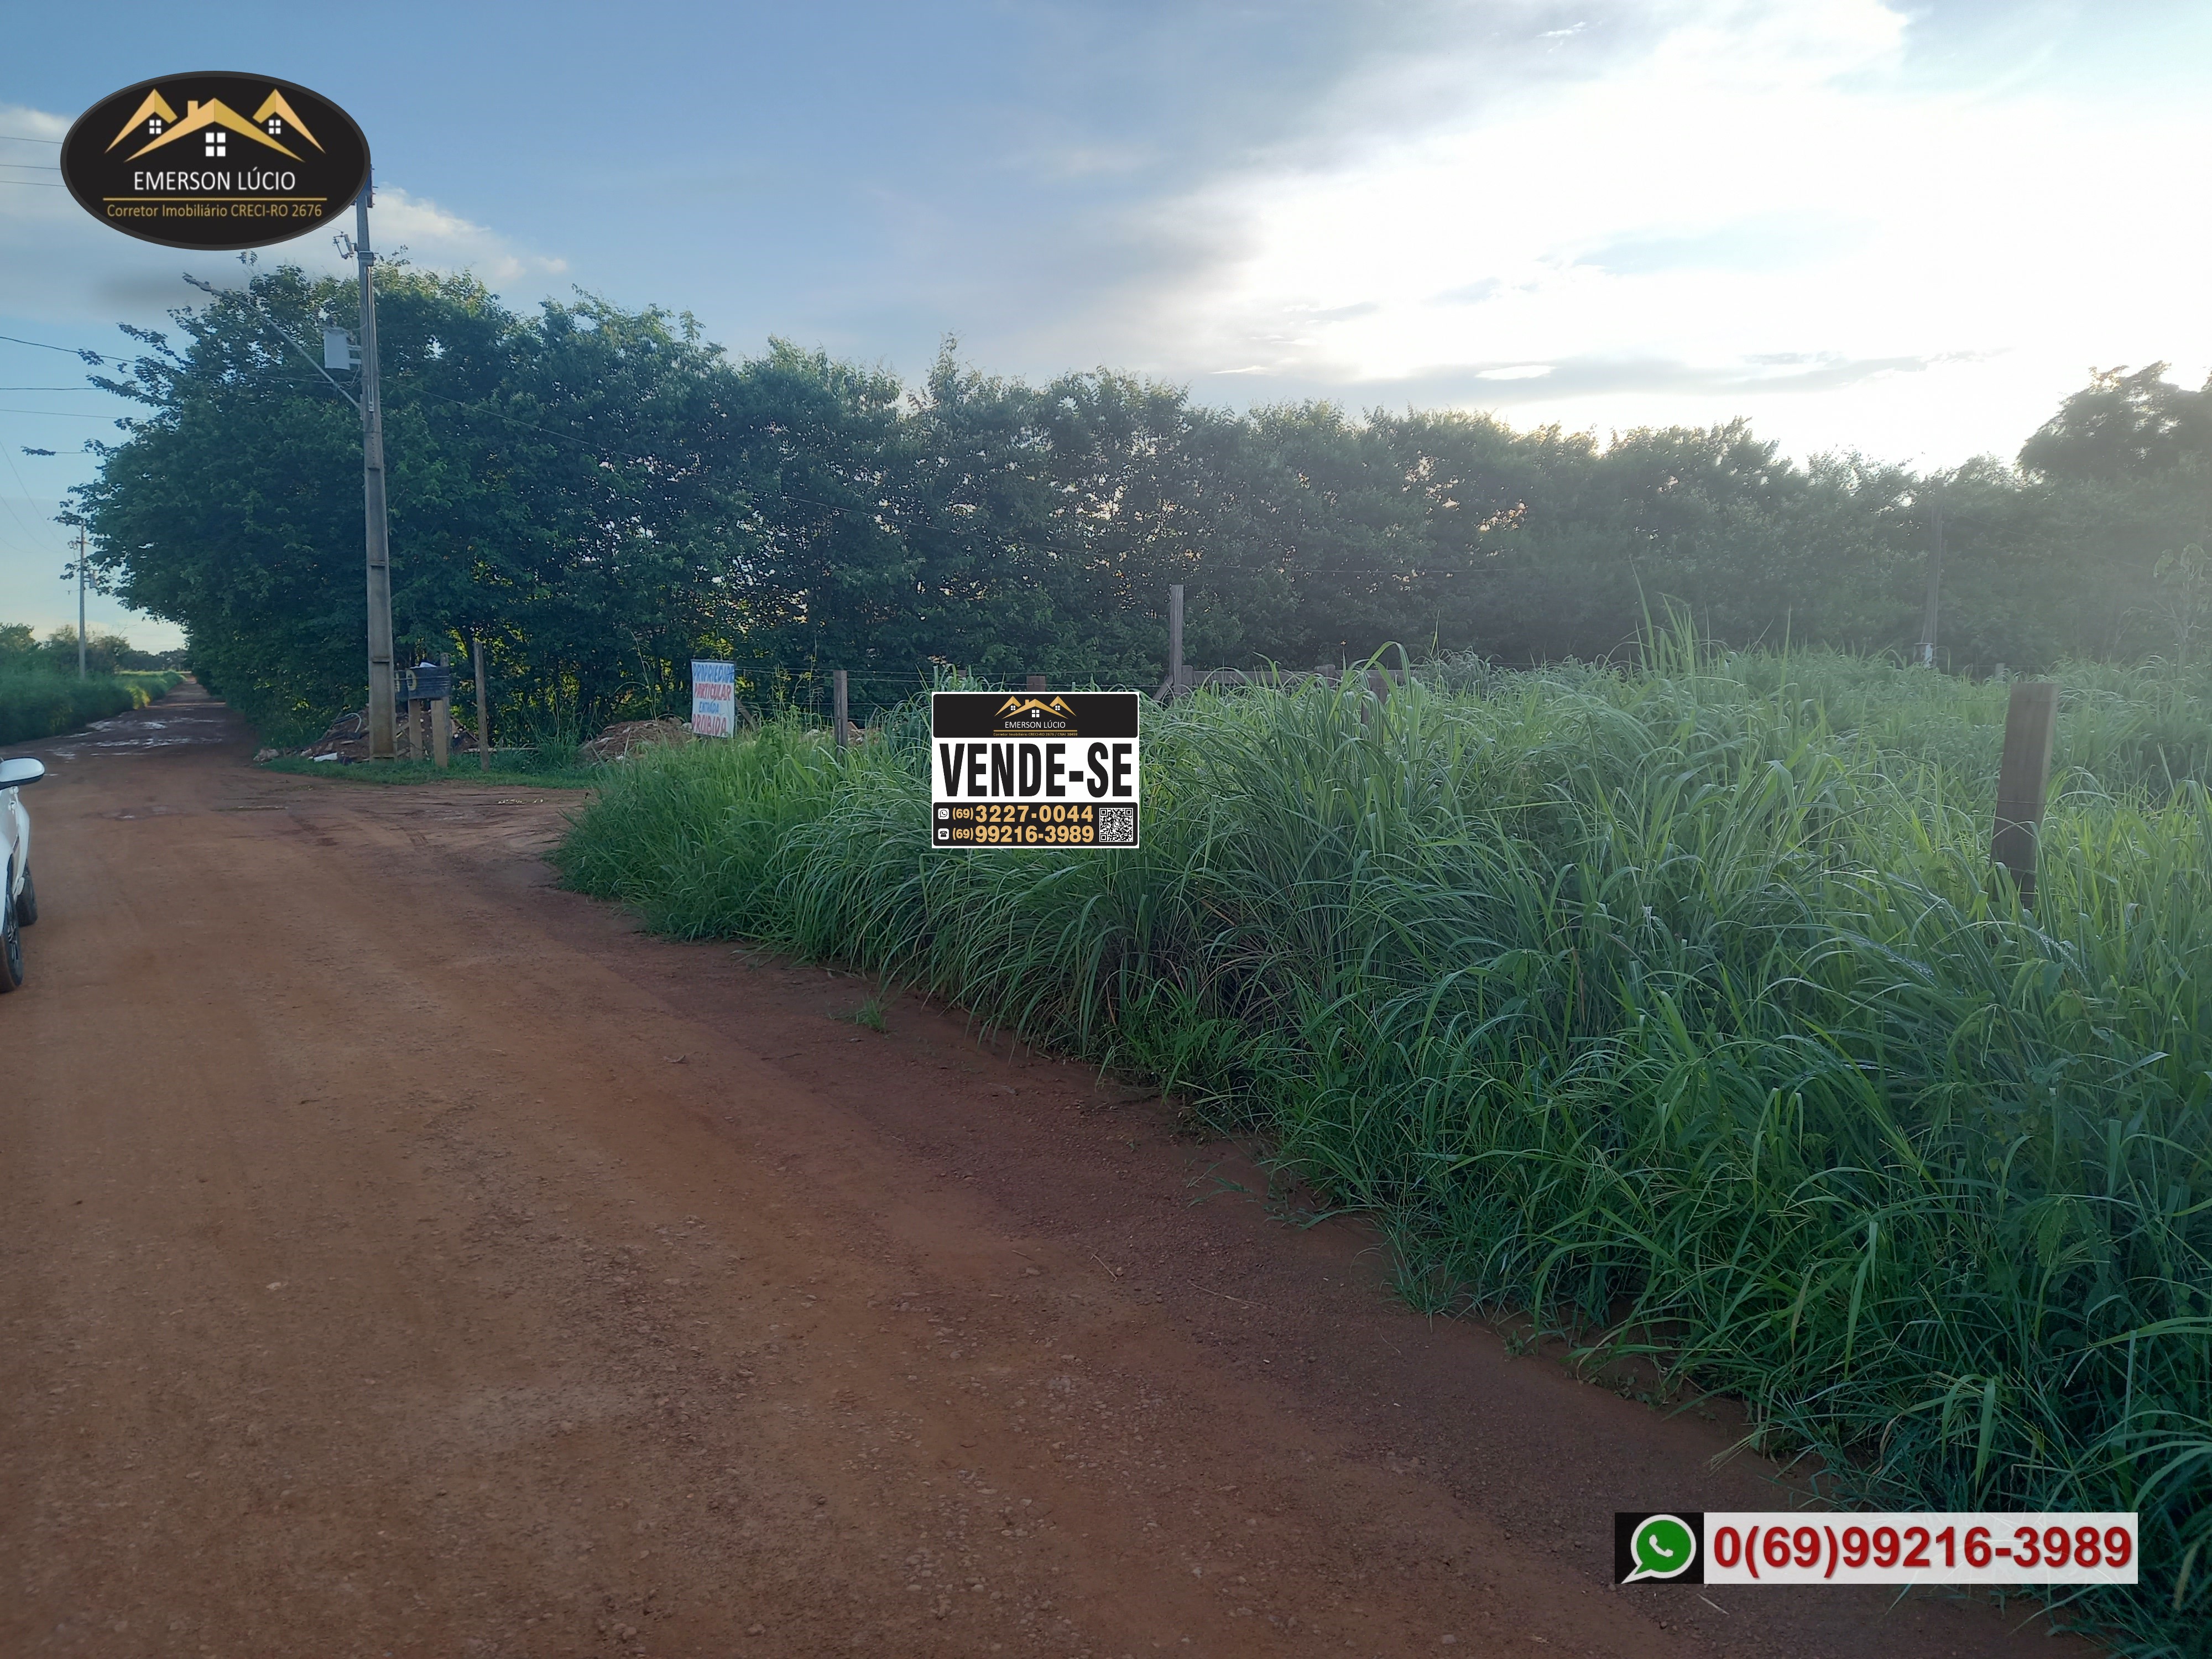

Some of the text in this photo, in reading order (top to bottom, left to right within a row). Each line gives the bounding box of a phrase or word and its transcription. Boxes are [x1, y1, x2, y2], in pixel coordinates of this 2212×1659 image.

[694, 683, 732, 701] PARTICULAR
[699, 701, 719, 714] ENTRADA
[693, 713, 727, 736] PROIBIDA
